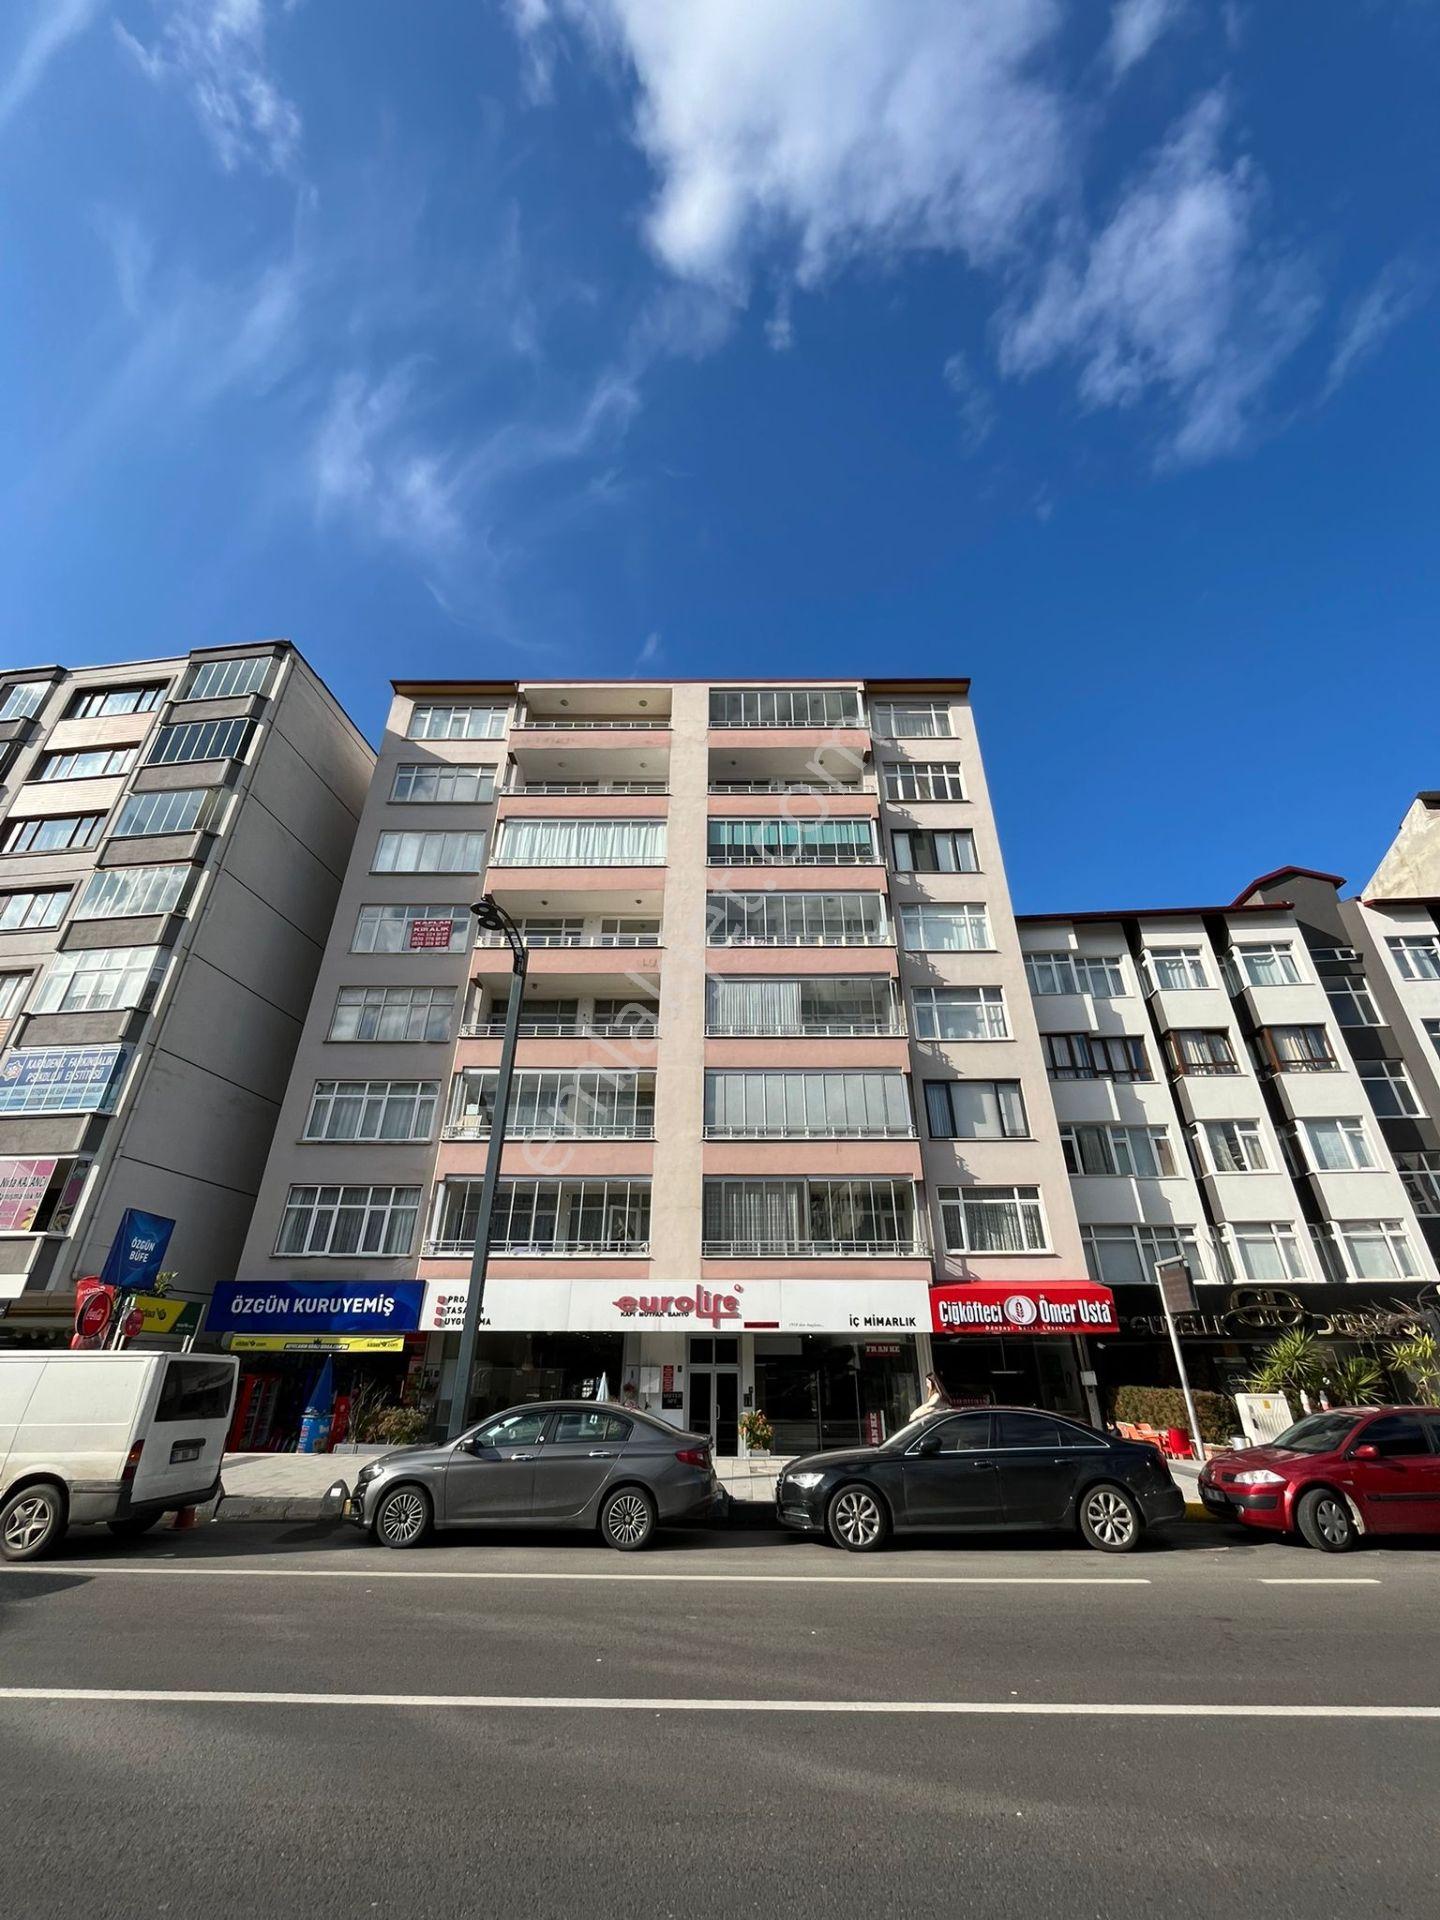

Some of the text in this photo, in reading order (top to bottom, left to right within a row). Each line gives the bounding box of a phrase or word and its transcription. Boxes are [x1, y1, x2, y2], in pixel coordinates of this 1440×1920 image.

[131, 1236, 156, 1252] ÖZGÜN
[129, 1249, 149, 1263] BÜFE
[231, 1293, 395, 1317] ÖZGÜN KURUYEMİŞ
[612, 1283, 742, 1330] eurolife
[938, 1294, 1112, 1327] Çiğköfteci Ömer Usta
[849, 1314, 917, 1328] İÇ MİMARLIK
